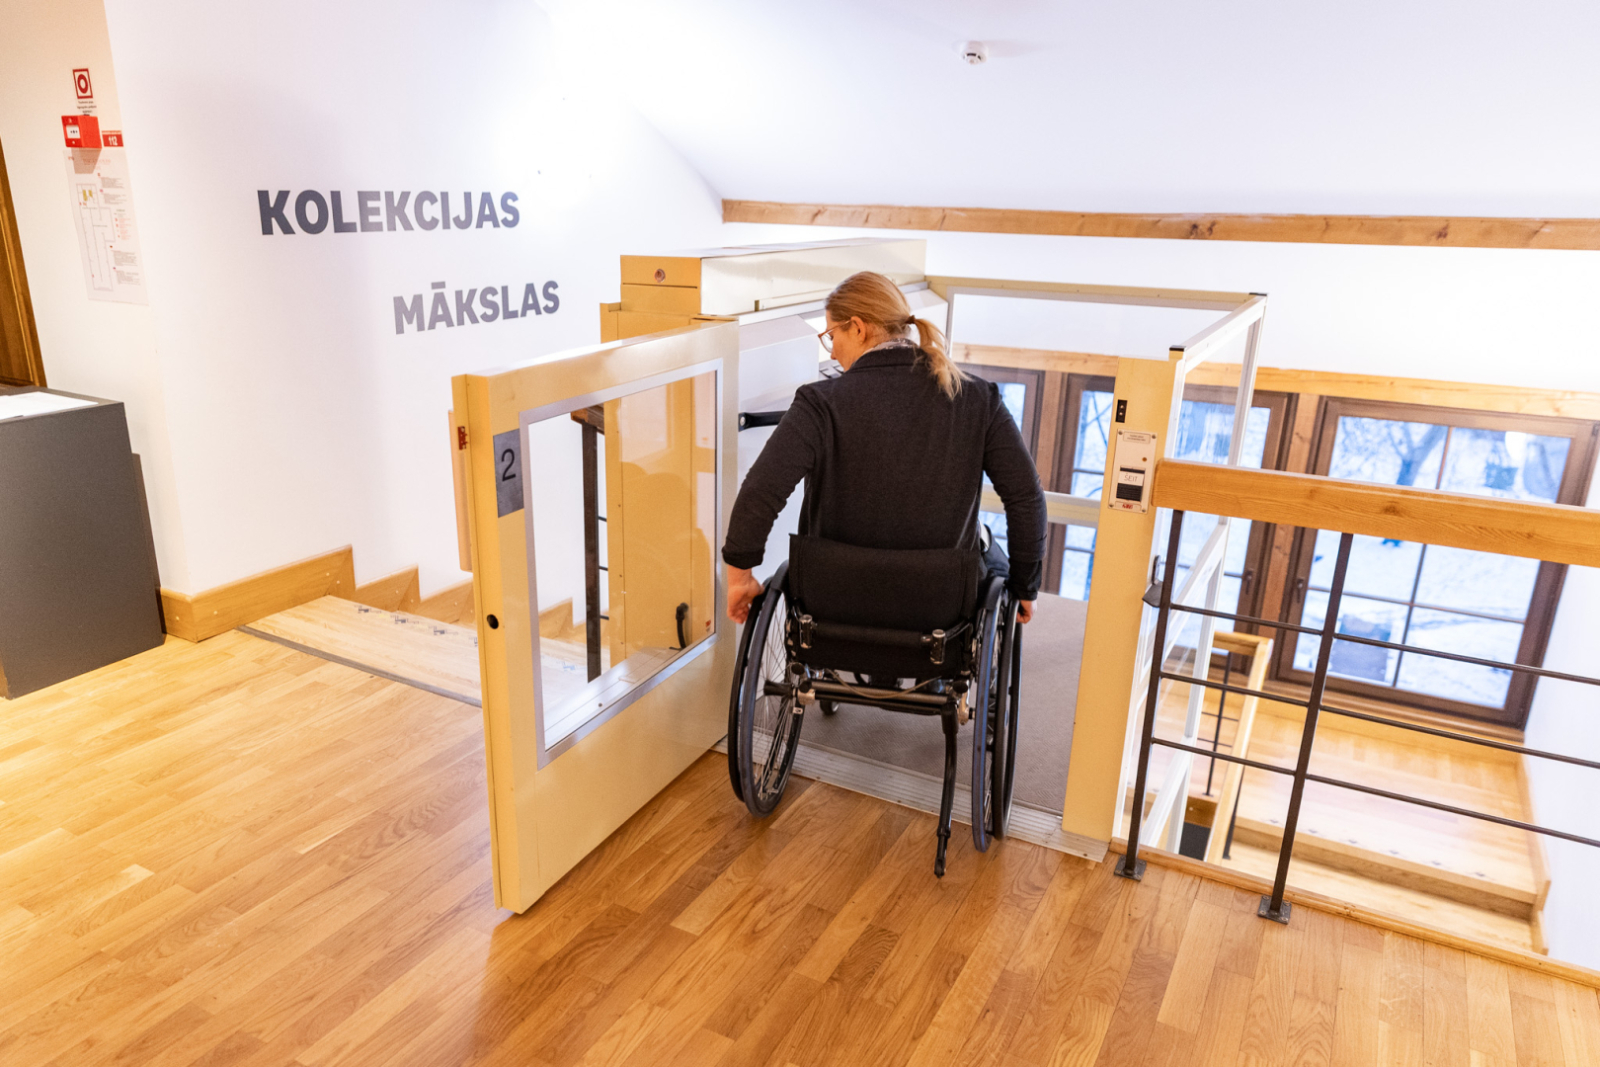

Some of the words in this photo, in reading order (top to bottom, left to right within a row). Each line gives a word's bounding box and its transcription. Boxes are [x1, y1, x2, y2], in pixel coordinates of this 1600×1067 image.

[108, 135, 119, 146] 112
[257, 189, 520, 235] KOLEKCIJAS
[393, 280, 560, 335] MĀKSLAS
[501, 448, 516, 481] 2
